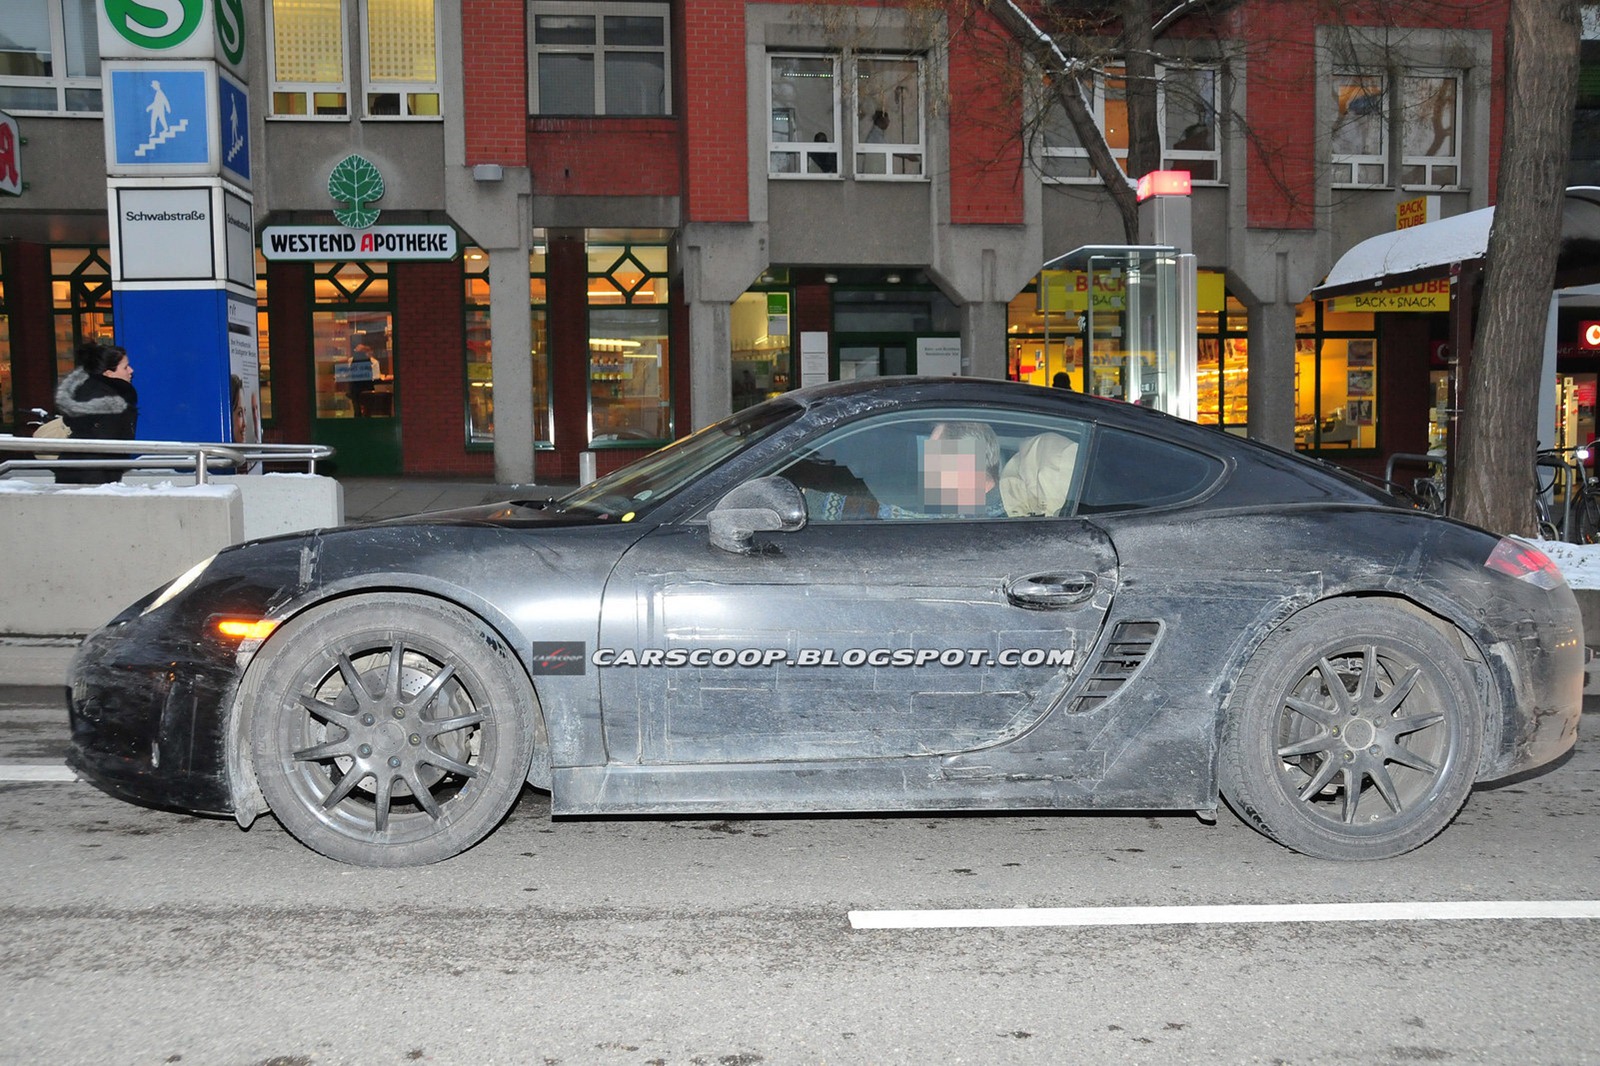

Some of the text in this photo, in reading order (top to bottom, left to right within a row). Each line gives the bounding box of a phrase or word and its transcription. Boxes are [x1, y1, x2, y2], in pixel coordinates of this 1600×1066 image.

[126, 211, 205, 221] Schwabstraße
[1399, 199, 1424, 216] BACK
[1397, 213, 1425, 230] STUBE
[271, 233, 448, 252] WESTEND APOTHEKE
[1355, 297, 1387, 307] BACK
[1397, 297, 1436, 308] SNACK
